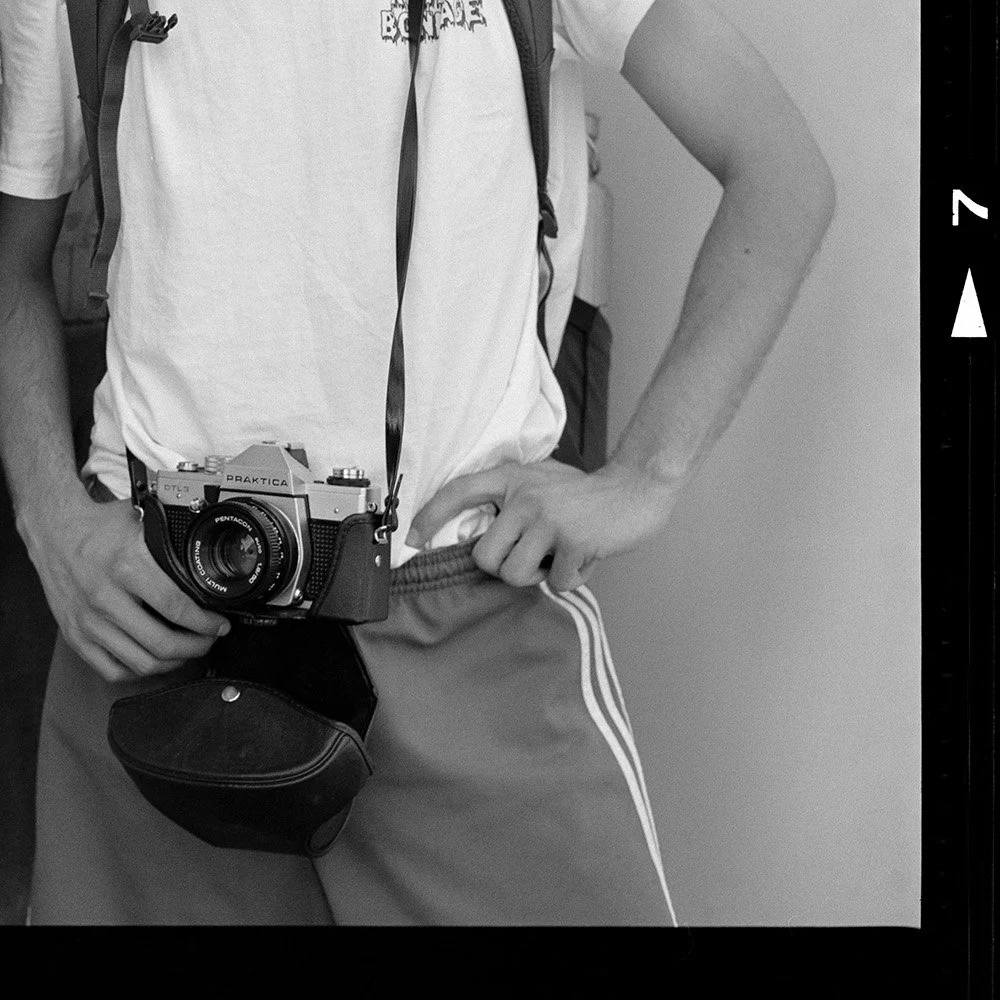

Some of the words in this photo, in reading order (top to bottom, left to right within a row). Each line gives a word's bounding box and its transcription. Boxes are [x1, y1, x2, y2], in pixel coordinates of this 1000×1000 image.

[951, 188, 989, 226] 7
[226, 474, 288, 487] PRAKTICA
[214, 515, 253, 532] PENTACON
[194, 540, 206, 576] COATING
[205, 577, 228, 593] MULTI
